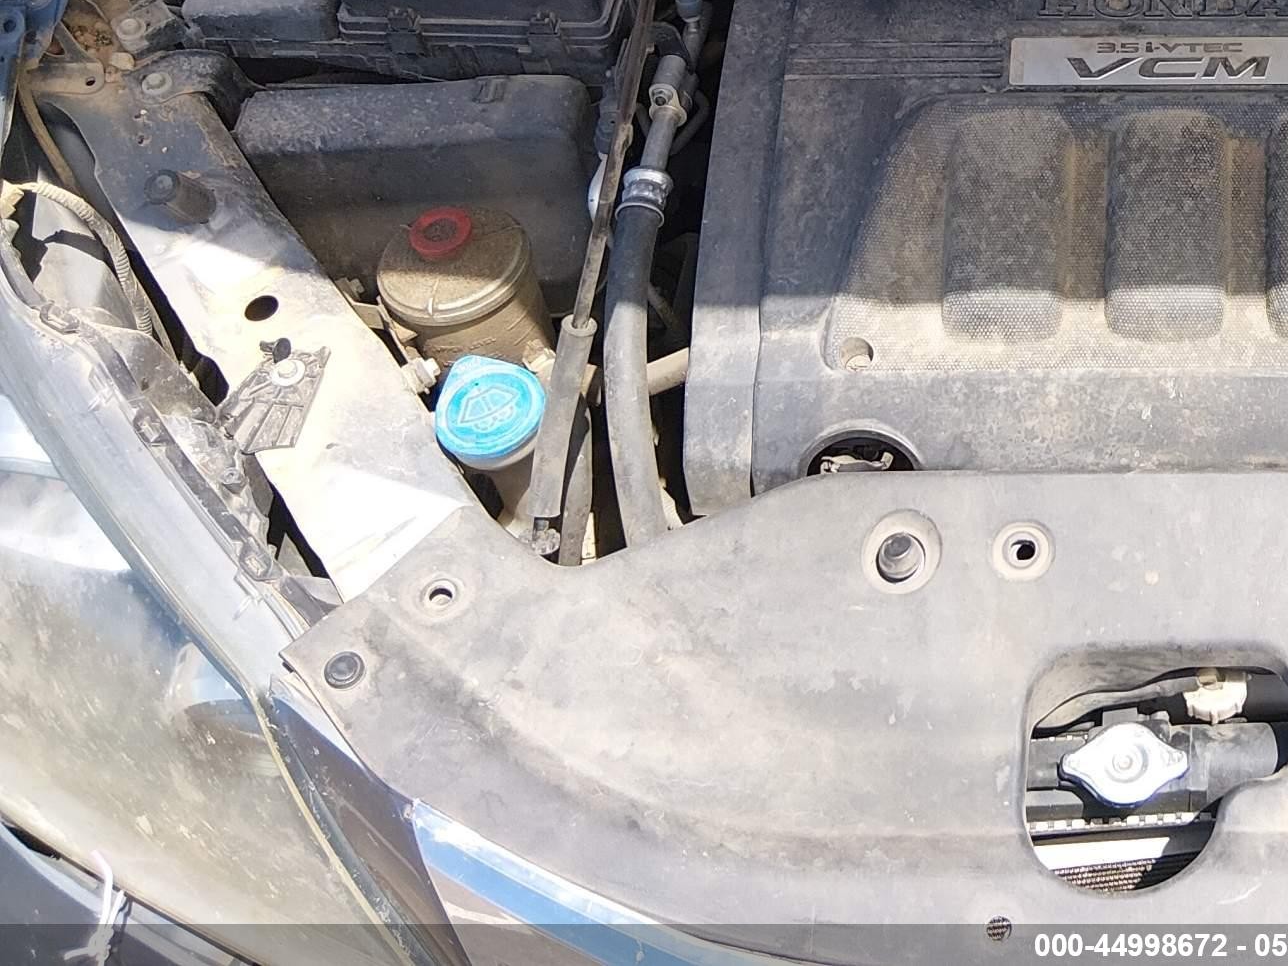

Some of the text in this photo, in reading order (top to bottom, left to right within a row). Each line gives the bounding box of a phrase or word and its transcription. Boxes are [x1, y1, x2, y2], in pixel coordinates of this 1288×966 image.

[1097, 42, 1243, 54] 3.5 i-VTEC
[1067, 56, 1272, 81] VCM
